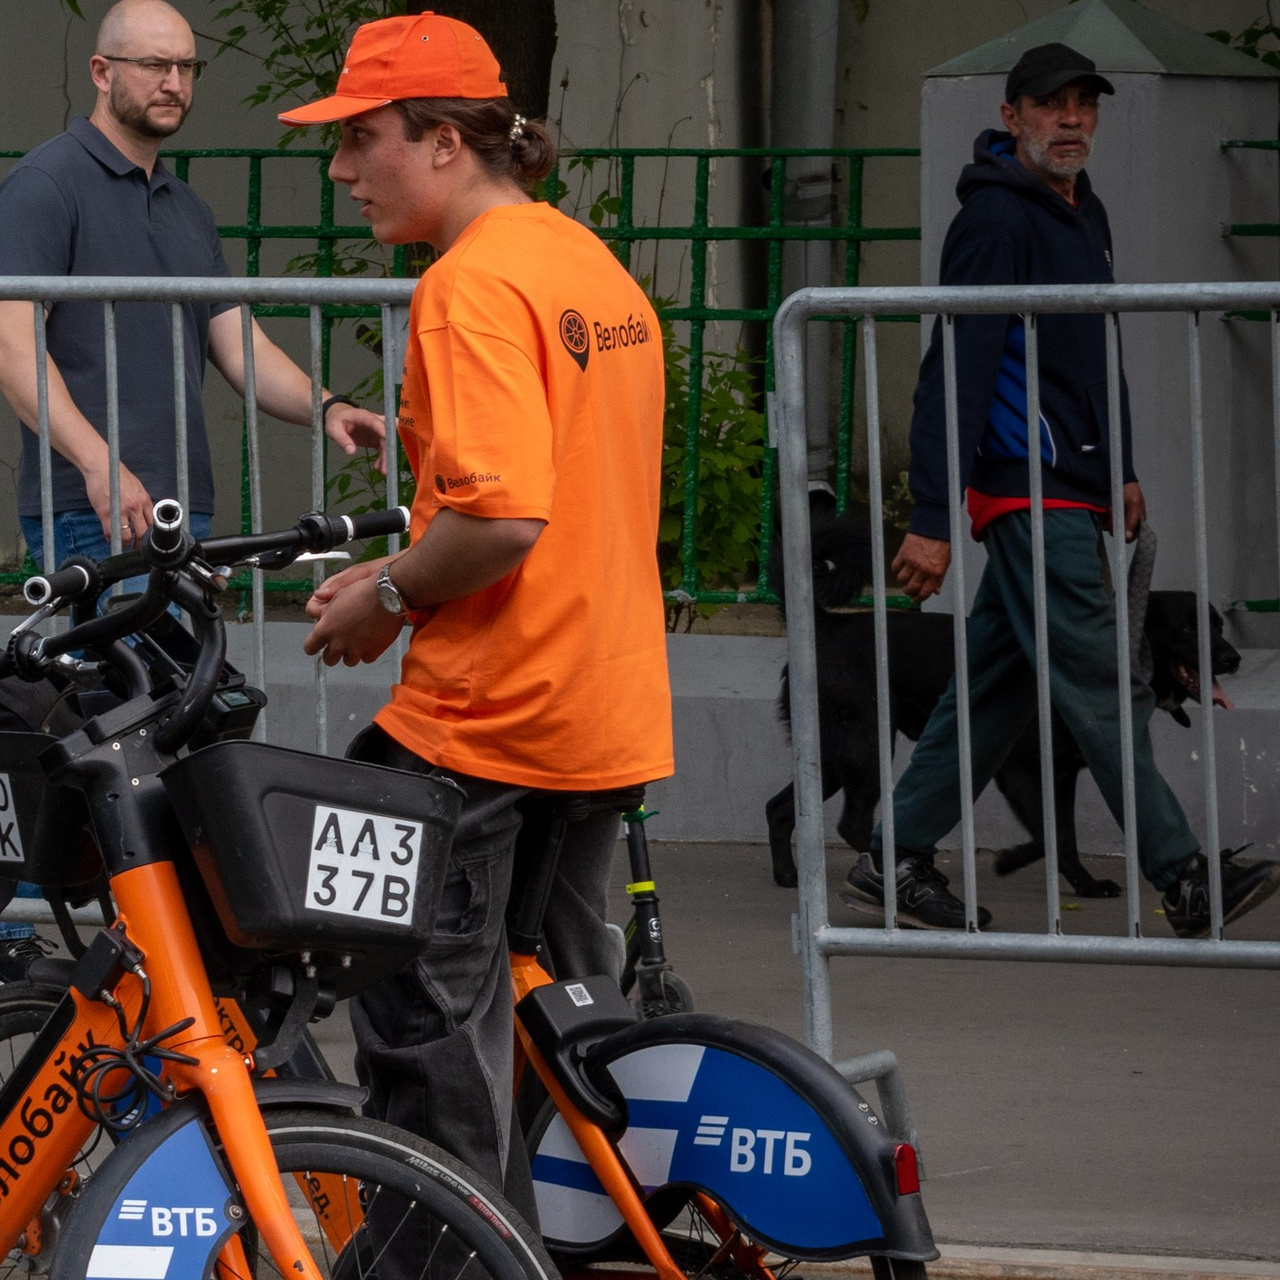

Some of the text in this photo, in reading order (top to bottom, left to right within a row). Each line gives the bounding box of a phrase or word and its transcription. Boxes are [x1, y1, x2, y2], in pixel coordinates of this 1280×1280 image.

[447, 473, 501, 489] Велобайк
[730, 1128, 812, 1176] ВТБ
[151, 1207, 217, 1236] ВТБ
